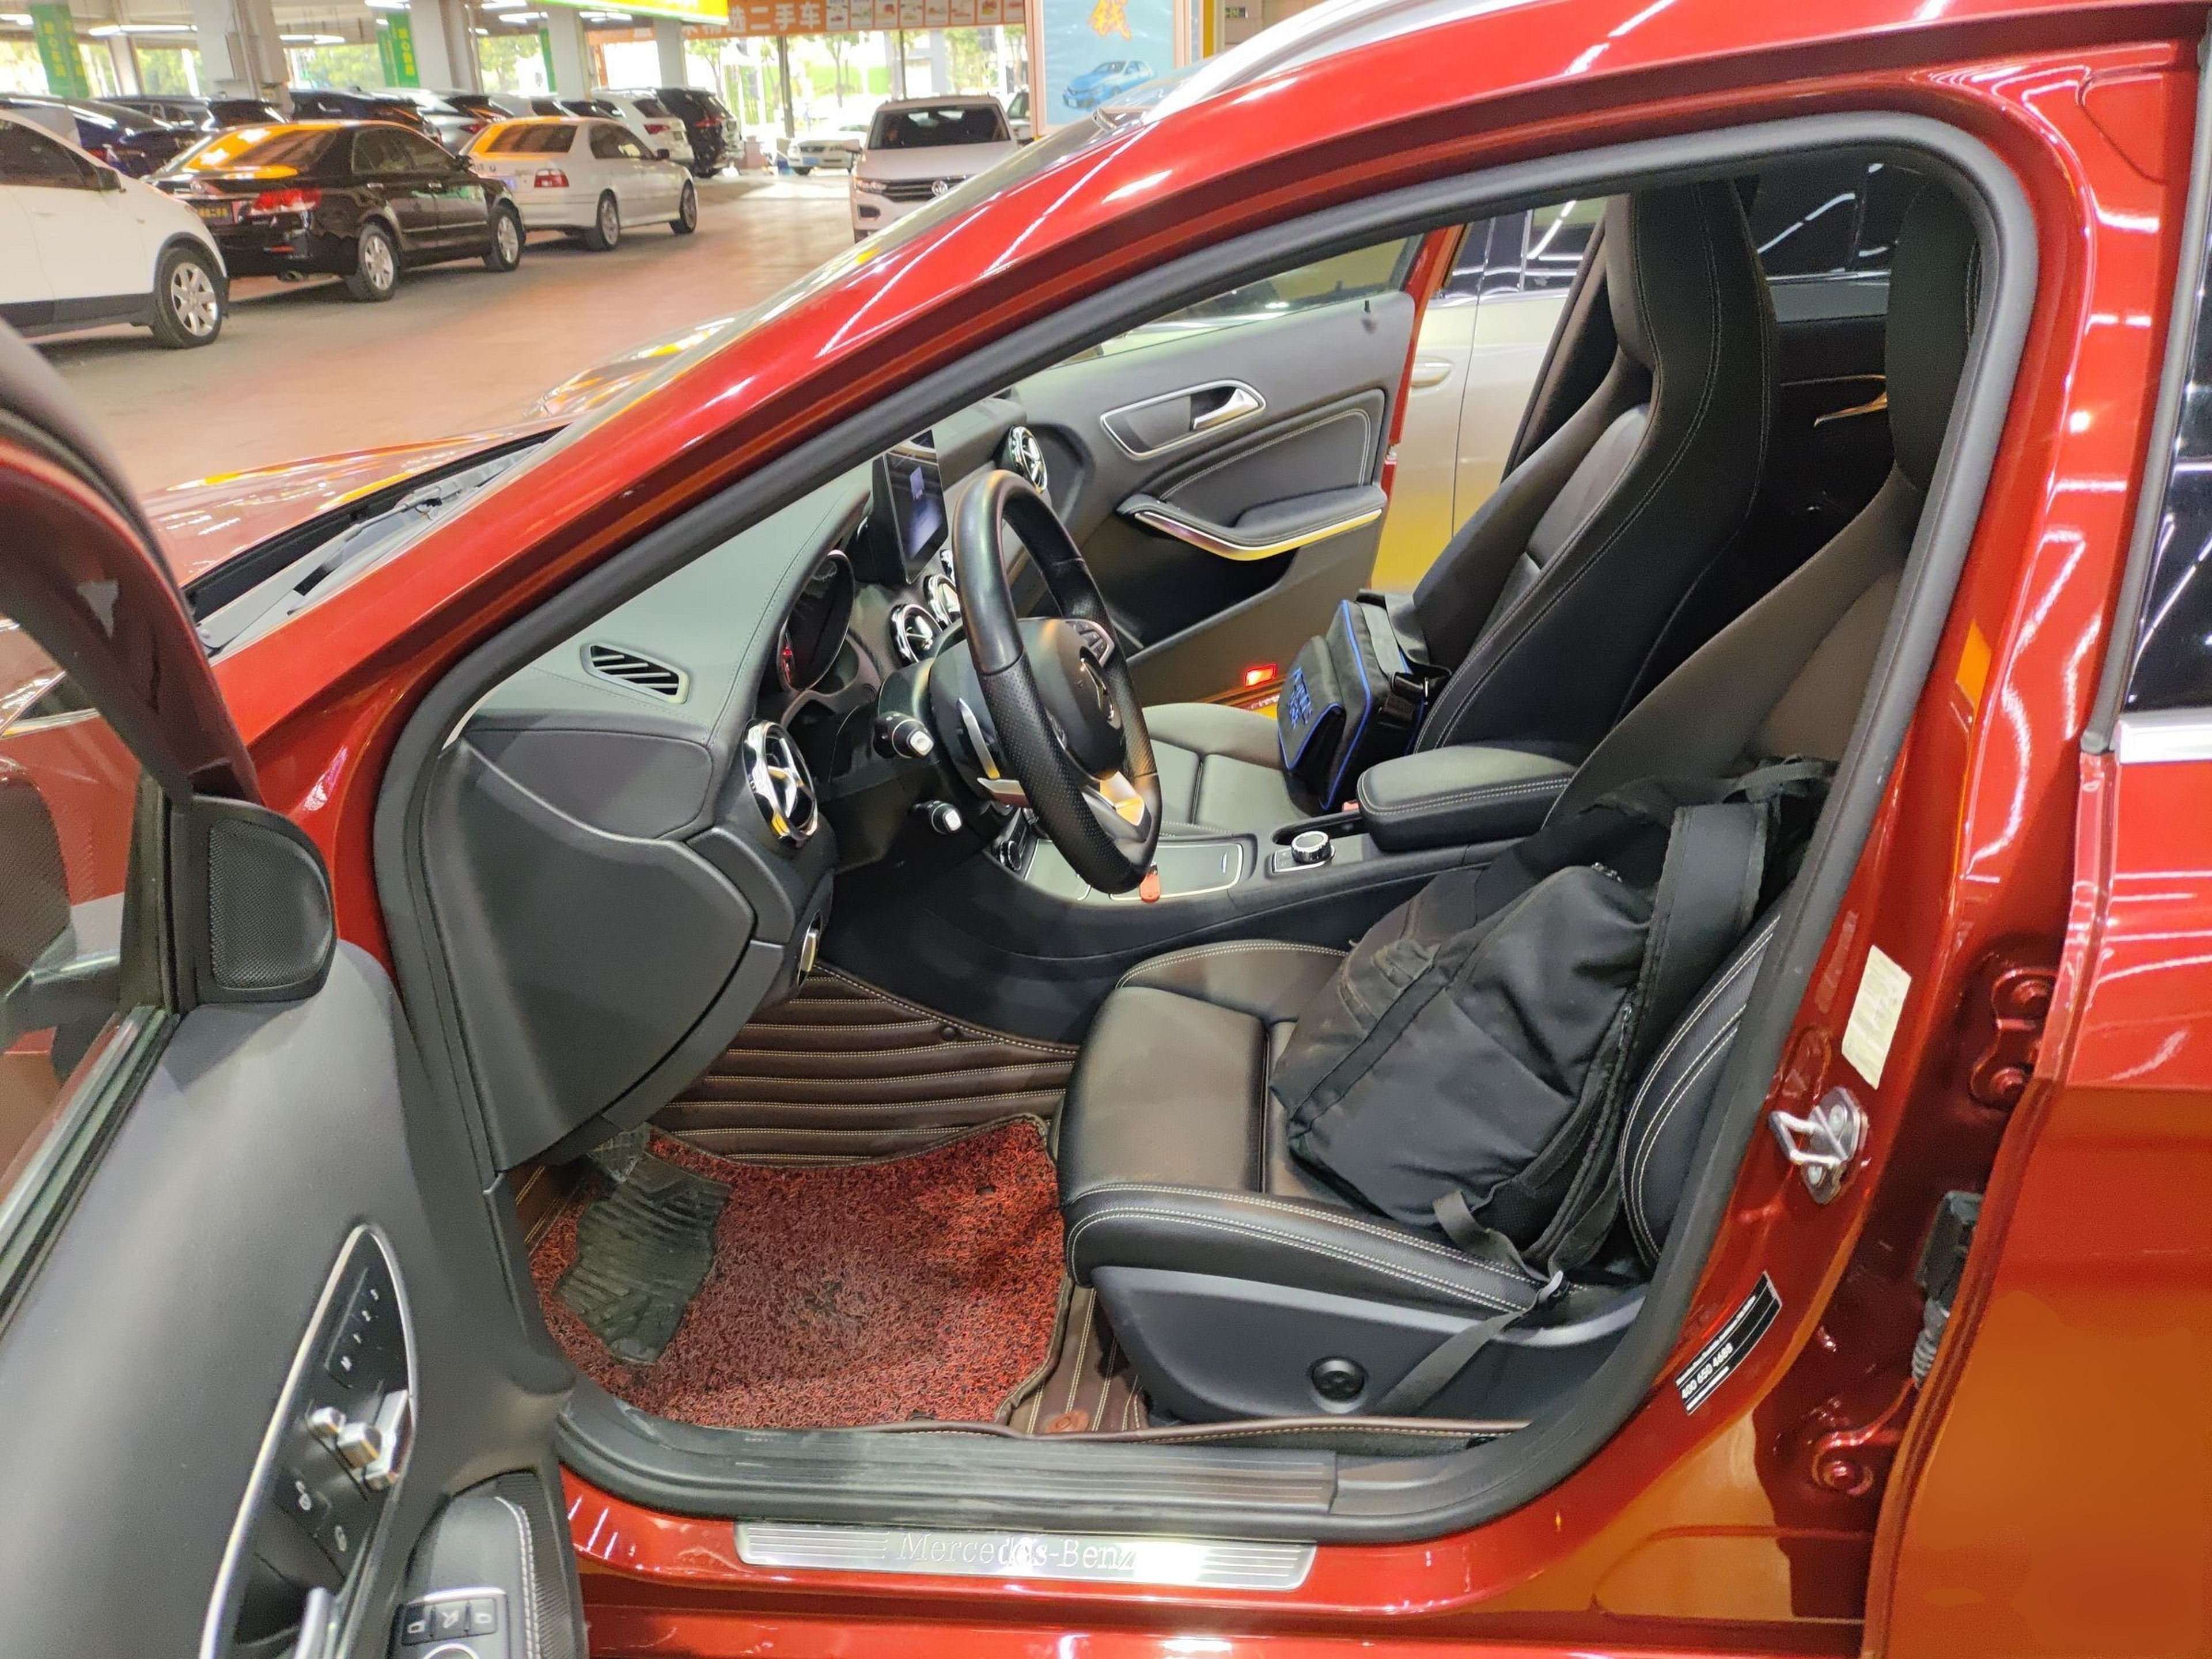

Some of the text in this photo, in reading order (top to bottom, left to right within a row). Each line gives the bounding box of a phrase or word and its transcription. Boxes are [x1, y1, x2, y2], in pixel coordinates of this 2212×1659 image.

[1682, 1380, 1697, 1399] 400
[1697, 1363, 1713, 1384] 650
[896, 1532, 1136, 1571] Mercedes-Benz
